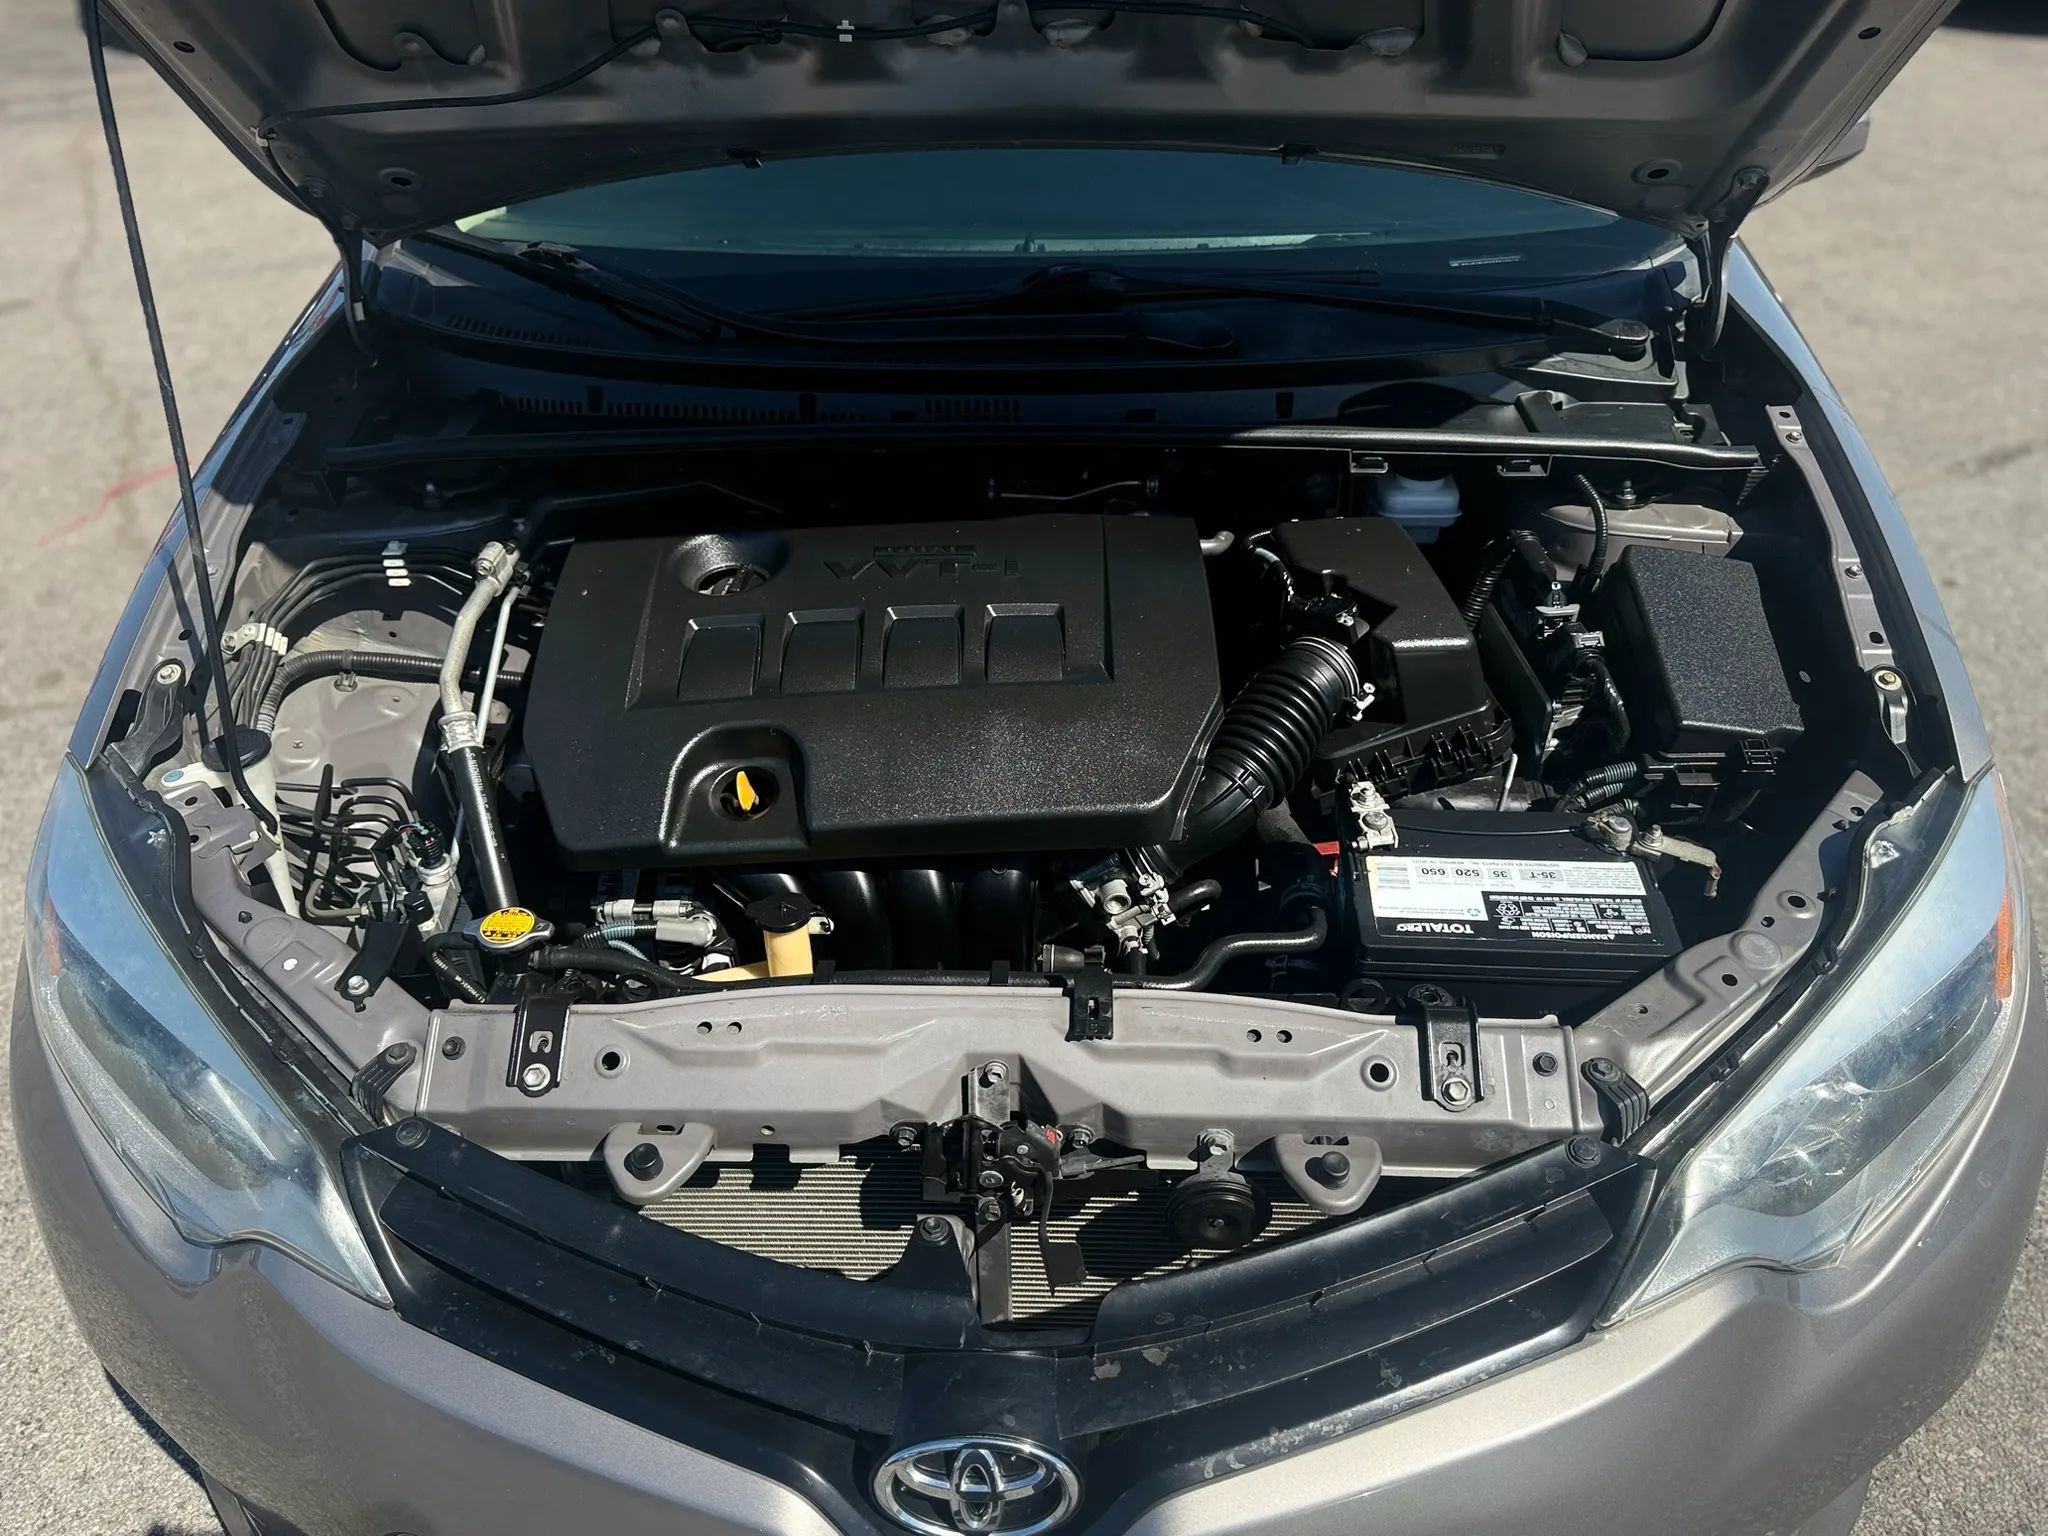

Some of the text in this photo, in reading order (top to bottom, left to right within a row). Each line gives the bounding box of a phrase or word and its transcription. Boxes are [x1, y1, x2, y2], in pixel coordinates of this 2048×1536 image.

[1421, 867, 1557, 879] 35-T 35 520 650
[1396, 923, 1475, 934] TOTALPRO
